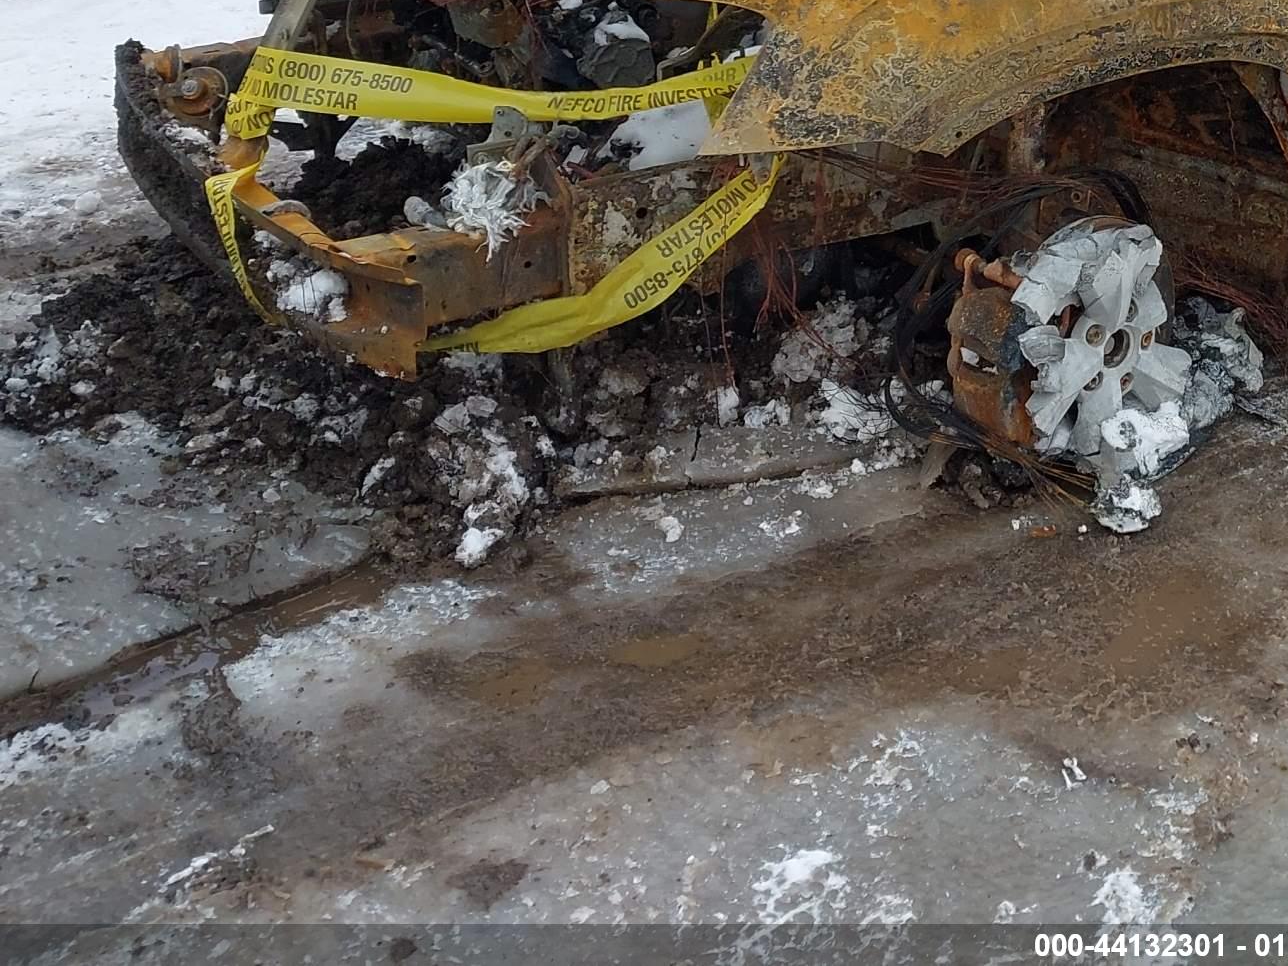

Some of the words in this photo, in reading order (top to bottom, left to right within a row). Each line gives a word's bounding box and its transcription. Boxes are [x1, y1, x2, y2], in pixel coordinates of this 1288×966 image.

[278, 57, 327, 84] (800)
[331, 67, 414, 94] 675-8500
[262, 80, 358, 111] MOLESTAR
[547, 95, 606, 114] NEFCO
[608, 93, 643, 113] FIRE
[655, 185, 748, 259] MOLESTAR
